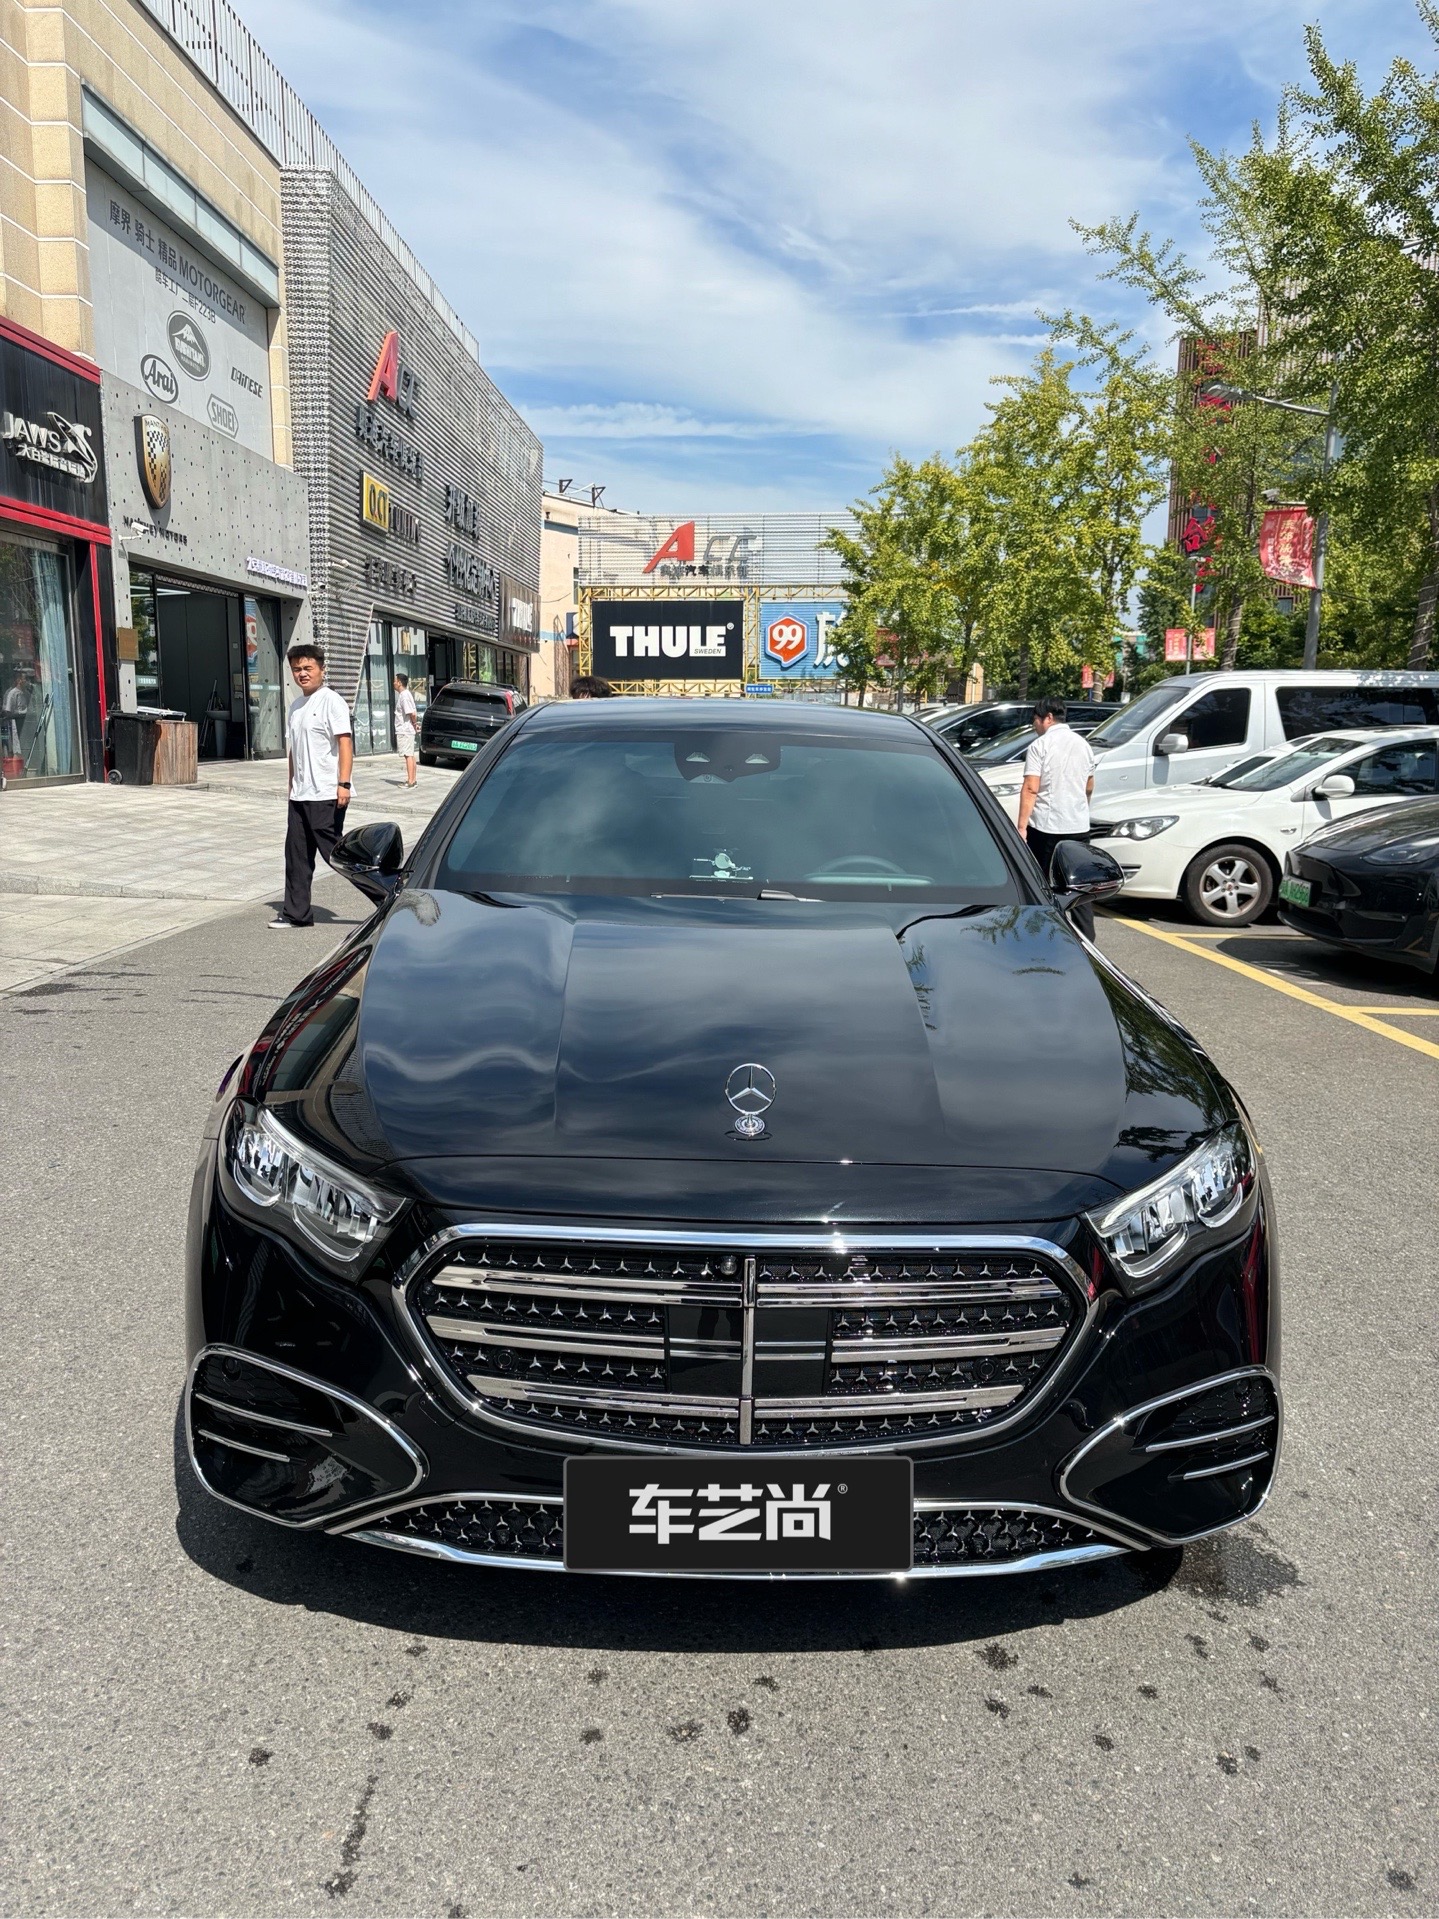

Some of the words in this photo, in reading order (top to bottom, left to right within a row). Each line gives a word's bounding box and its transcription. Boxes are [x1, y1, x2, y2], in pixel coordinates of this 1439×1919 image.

[135, 218, 154, 254] 骑士
[158, 238, 177, 272] 精品
[179, 256, 246, 324] MOTORGEAR
[145, 359, 175, 395] Arai
[2, 411, 61, 453] JAWS
[211, 402, 236, 433] SHOEI
[159, 526, 188, 547] MOTORS
[609, 625, 727, 658] THULE
[772, 624, 803, 651] 99
